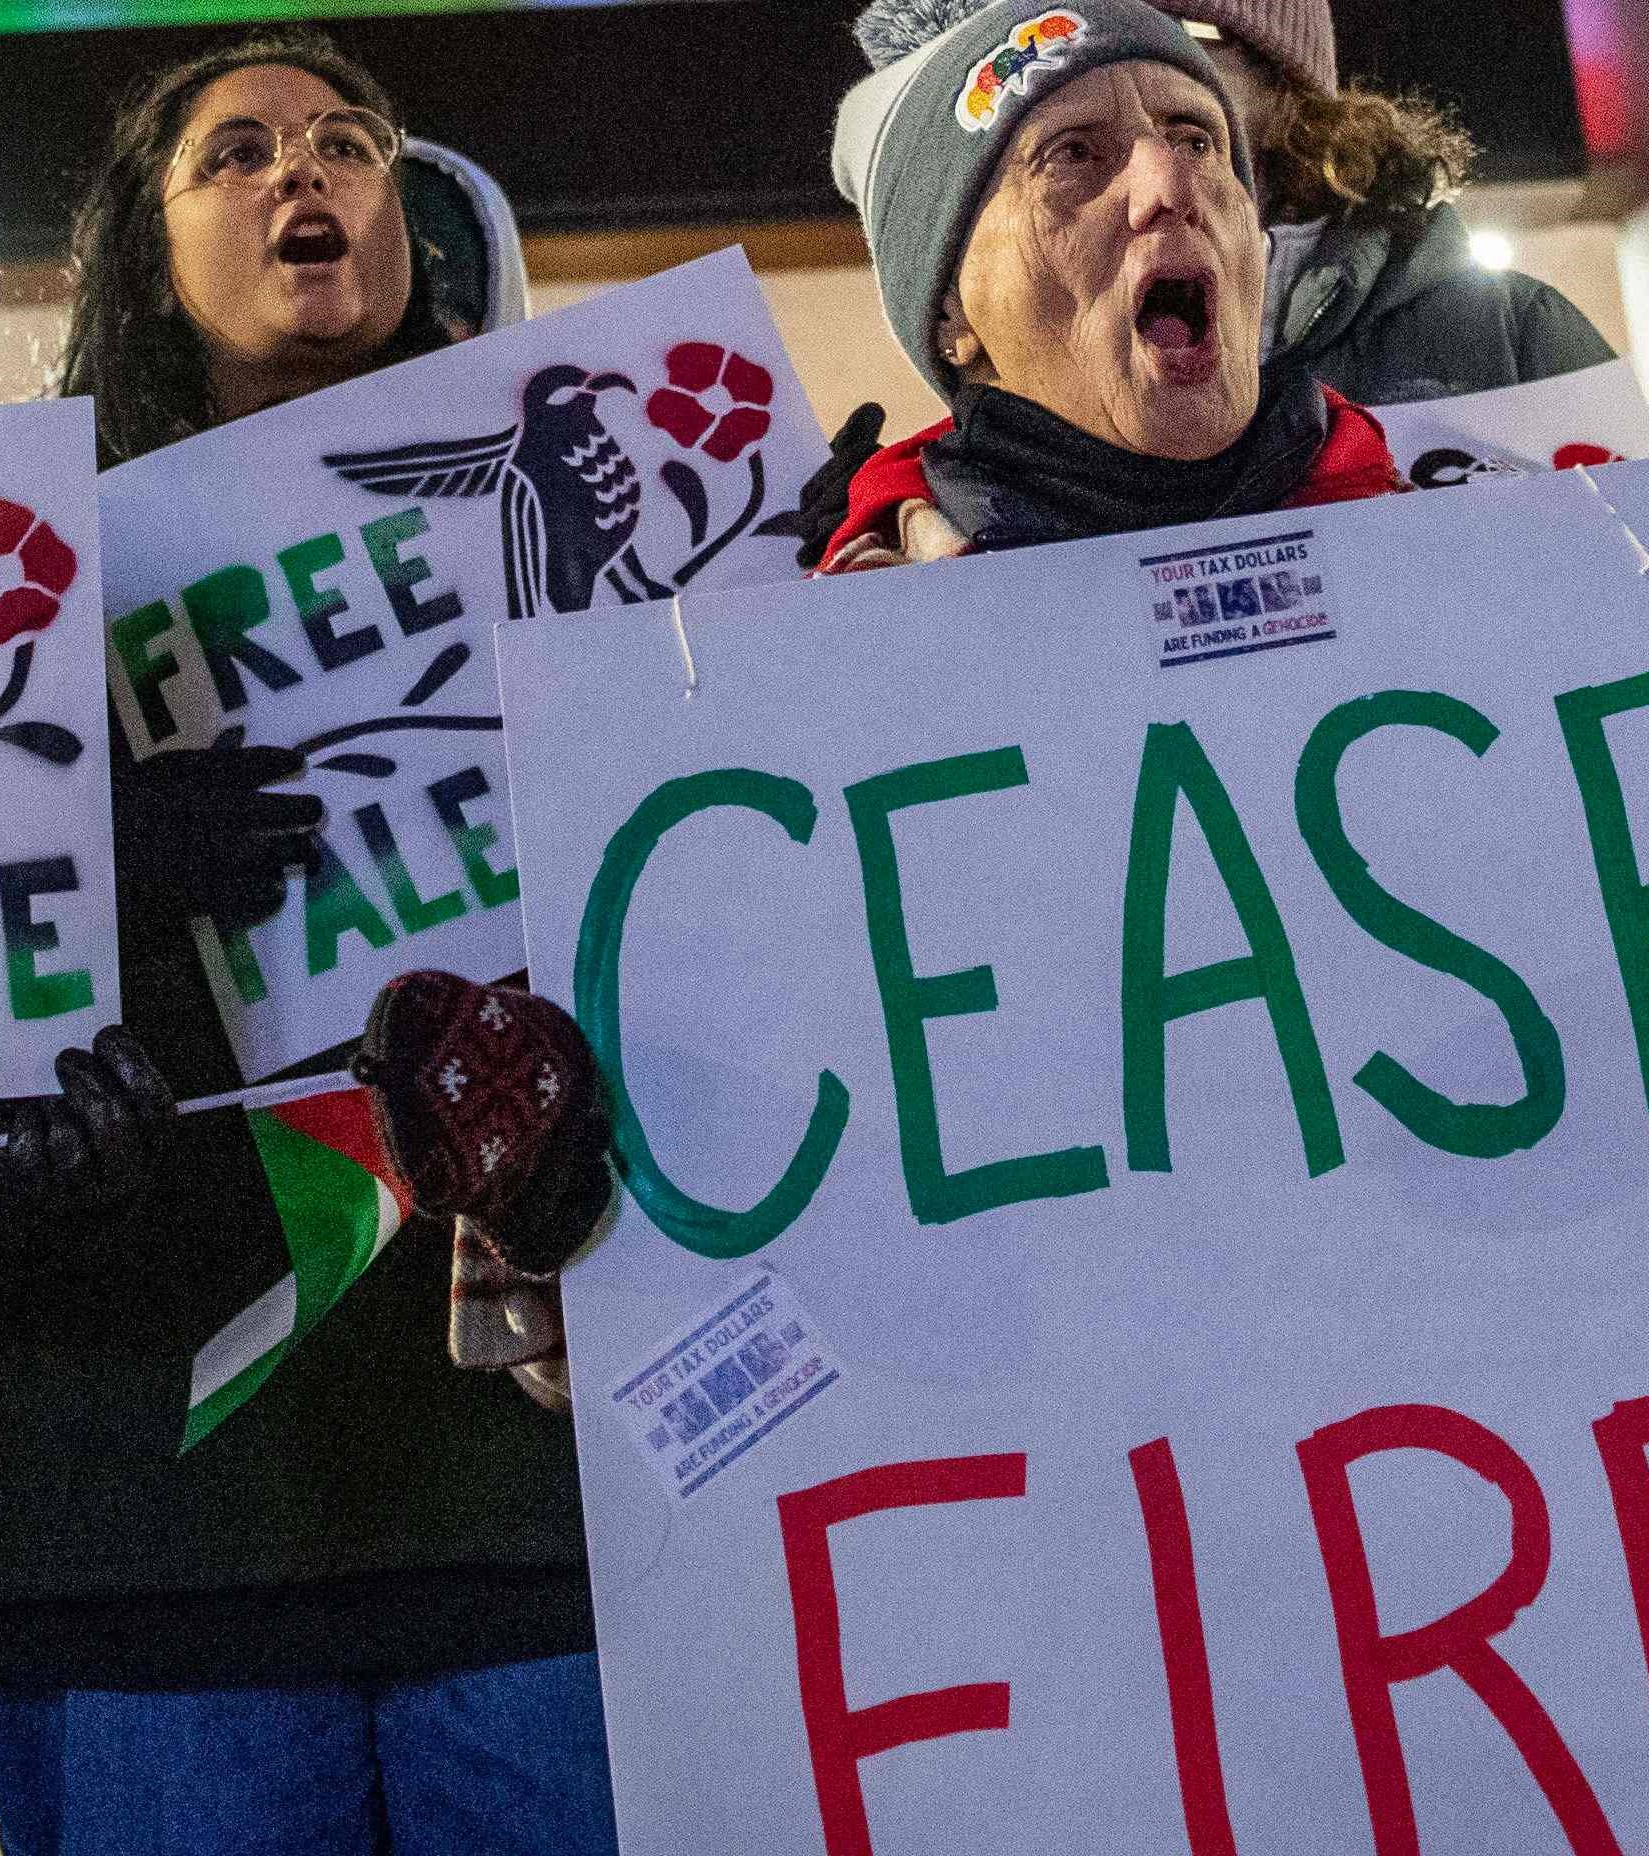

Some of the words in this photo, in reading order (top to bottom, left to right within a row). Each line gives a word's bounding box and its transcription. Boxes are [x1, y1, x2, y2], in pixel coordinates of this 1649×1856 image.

[1151, 562, 1195, 584] YOUR
[1199, 558, 1233, 577] TAX
[1234, 543, 1308, 571] DOLLARS
[112, 506, 464, 746] FREE
[1163, 635, 1188, 654] ARE
[1190, 626, 1247, 648] FUNDING
[1251, 624, 1262, 639] A
[1262, 612, 1330, 636] GENOCIDE
[671, 1348, 706, 1380] TAX
[704, 1294, 776, 1357] DOLLARS
